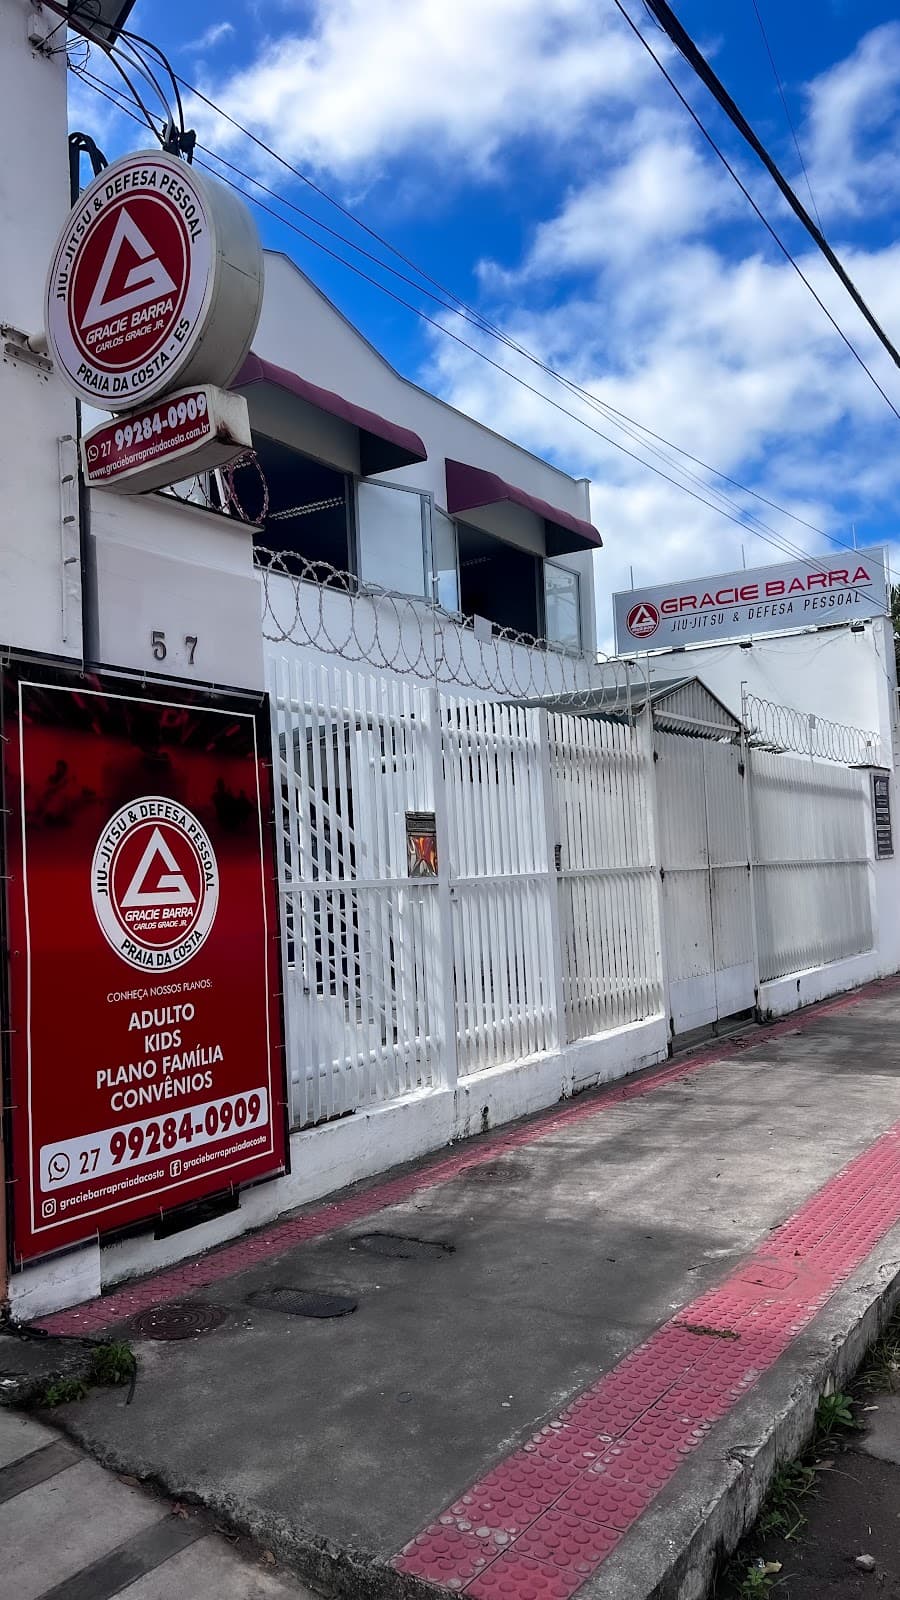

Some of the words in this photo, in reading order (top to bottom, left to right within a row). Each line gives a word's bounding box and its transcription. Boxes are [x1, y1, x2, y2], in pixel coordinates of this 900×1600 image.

[57, 213, 92, 301] JIU-JITSU
[93, 199, 104, 212] &
[105, 170, 157, 201] DEFESA
[159, 174, 203, 243] PESSOAL
[86, 318, 127, 345] GRACIE
[131, 298, 173, 327] BARRA
[95, 336, 124, 353] CARLOS
[125, 325, 152, 343] GRACIE
[77, 363, 110, 392] PRAIA
[112, 377, 129, 392] DA
[131, 351, 170, 387] COSTA
[174, 317, 190, 343] ES
[101, 441, 111, 458] 27
[115, 393, 207, 451] 99284-0909
[88, 423, 210, 479] www.graciebarrapraiadacosta.com.br
[660, 584, 759, 614] GRACIE
[765, 566, 870, 597] BARRA
[671, 614, 724, 632] JIU-JITSU
[733, 612, 740, 622] &
[748, 601, 793, 620] DEFESA
[803, 592, 861, 611] PESSOAL
[97, 820, 127, 896] JIU-JITSU
[128, 811, 138, 823] &
[140, 803, 186, 828] DEFESA
[188, 824, 215, 891] PESSOAL
[125, 908, 161, 922] GRACIE
[162, 906, 193, 919] BARRA
[133, 922, 156, 931] CARLOS
[158, 920, 178, 929] GRACIE
[121, 939, 154, 966] PRAIA
[157, 953, 171, 966] DA
[173, 930, 203, 961] COSTA
[107, 989, 148, 1003] CONHEÇA
[150, 984, 182, 996] NOSSOS
[183, 979, 213, 991] PLANOS:
[128, 1002, 195, 1031] ADULTO
[144, 1029, 182, 1053] KIDS
[96, 1059, 157, 1089] PLANO
[162, 1044, 224, 1075] FAMÍLIA
[110, 1070, 213, 1112] CONVÊNIOS
[79, 1148, 100, 1175] 27
[109, 1093, 261, 1165] 99284-0909
[183, 1135, 267, 1171] graciebarrapraiadacosta
[59, 1169, 165, 1211] graciebarrapraiadacosta
